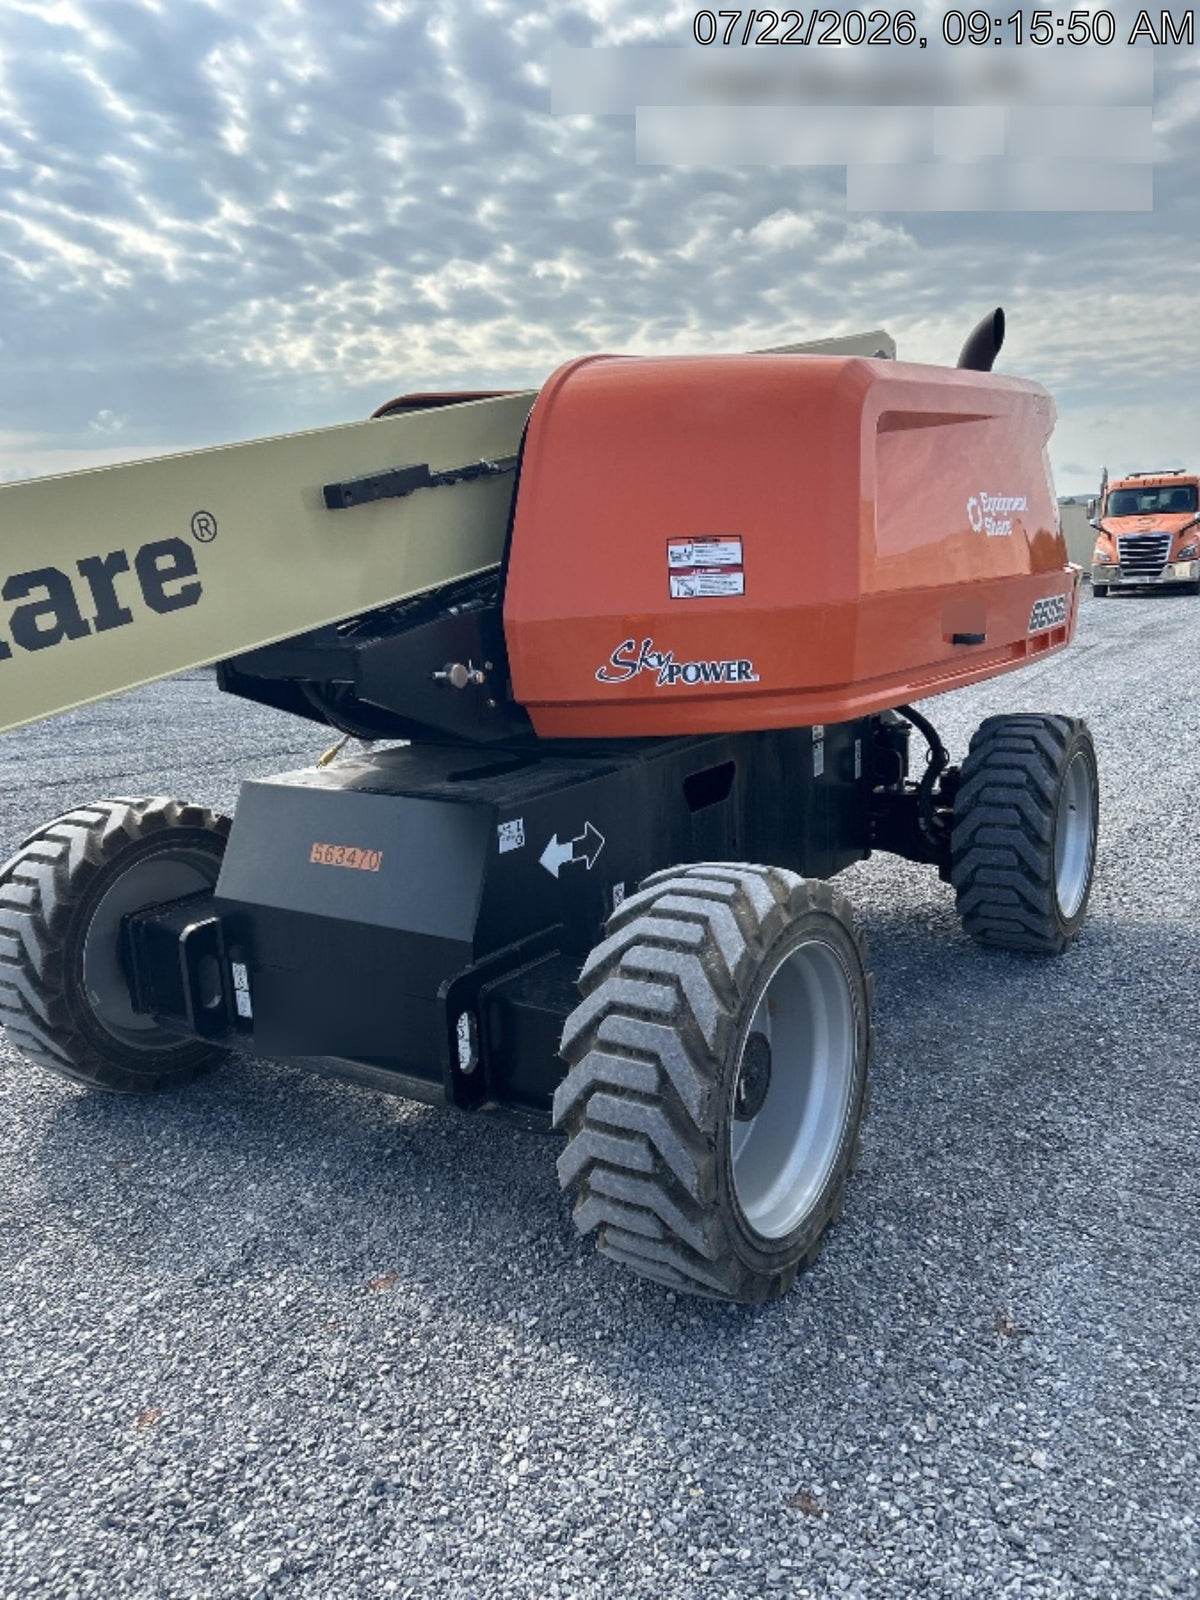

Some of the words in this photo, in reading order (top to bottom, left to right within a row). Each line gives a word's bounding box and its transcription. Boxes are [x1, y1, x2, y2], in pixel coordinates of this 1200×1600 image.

[0, 537, 203, 660] are
[595, 637, 674, 687] Sky
[668, 660, 755, 684] POWER
